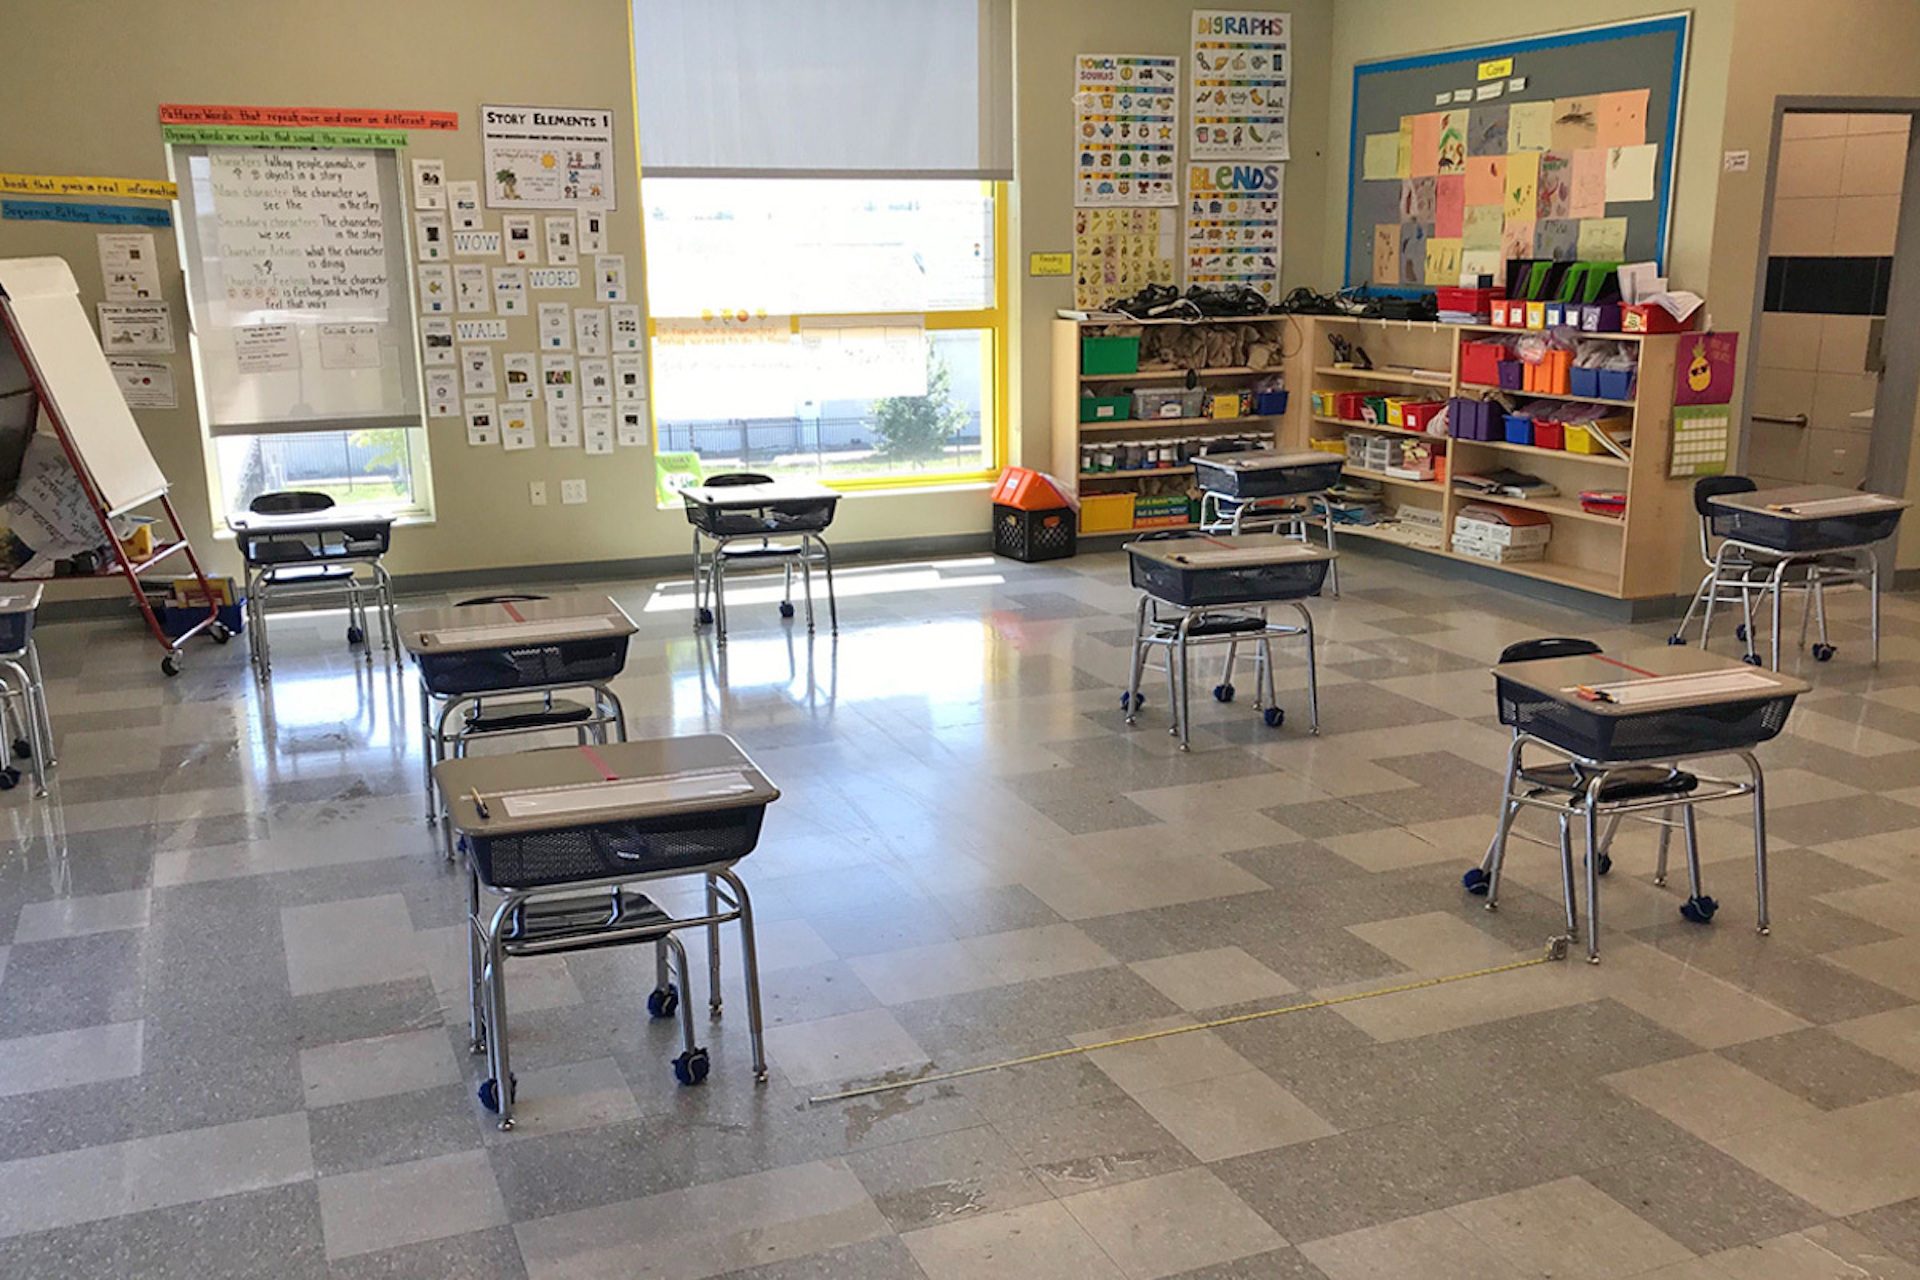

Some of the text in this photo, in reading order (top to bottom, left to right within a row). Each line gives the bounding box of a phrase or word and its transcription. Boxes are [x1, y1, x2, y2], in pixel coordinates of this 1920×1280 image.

[486, 111, 526, 125] STORY
[533, 113, 597, 127] ELEMENTS
[453, 234, 499, 251] WOW
[529, 270, 578, 287] WORD
[457, 323, 506, 339] WALL
